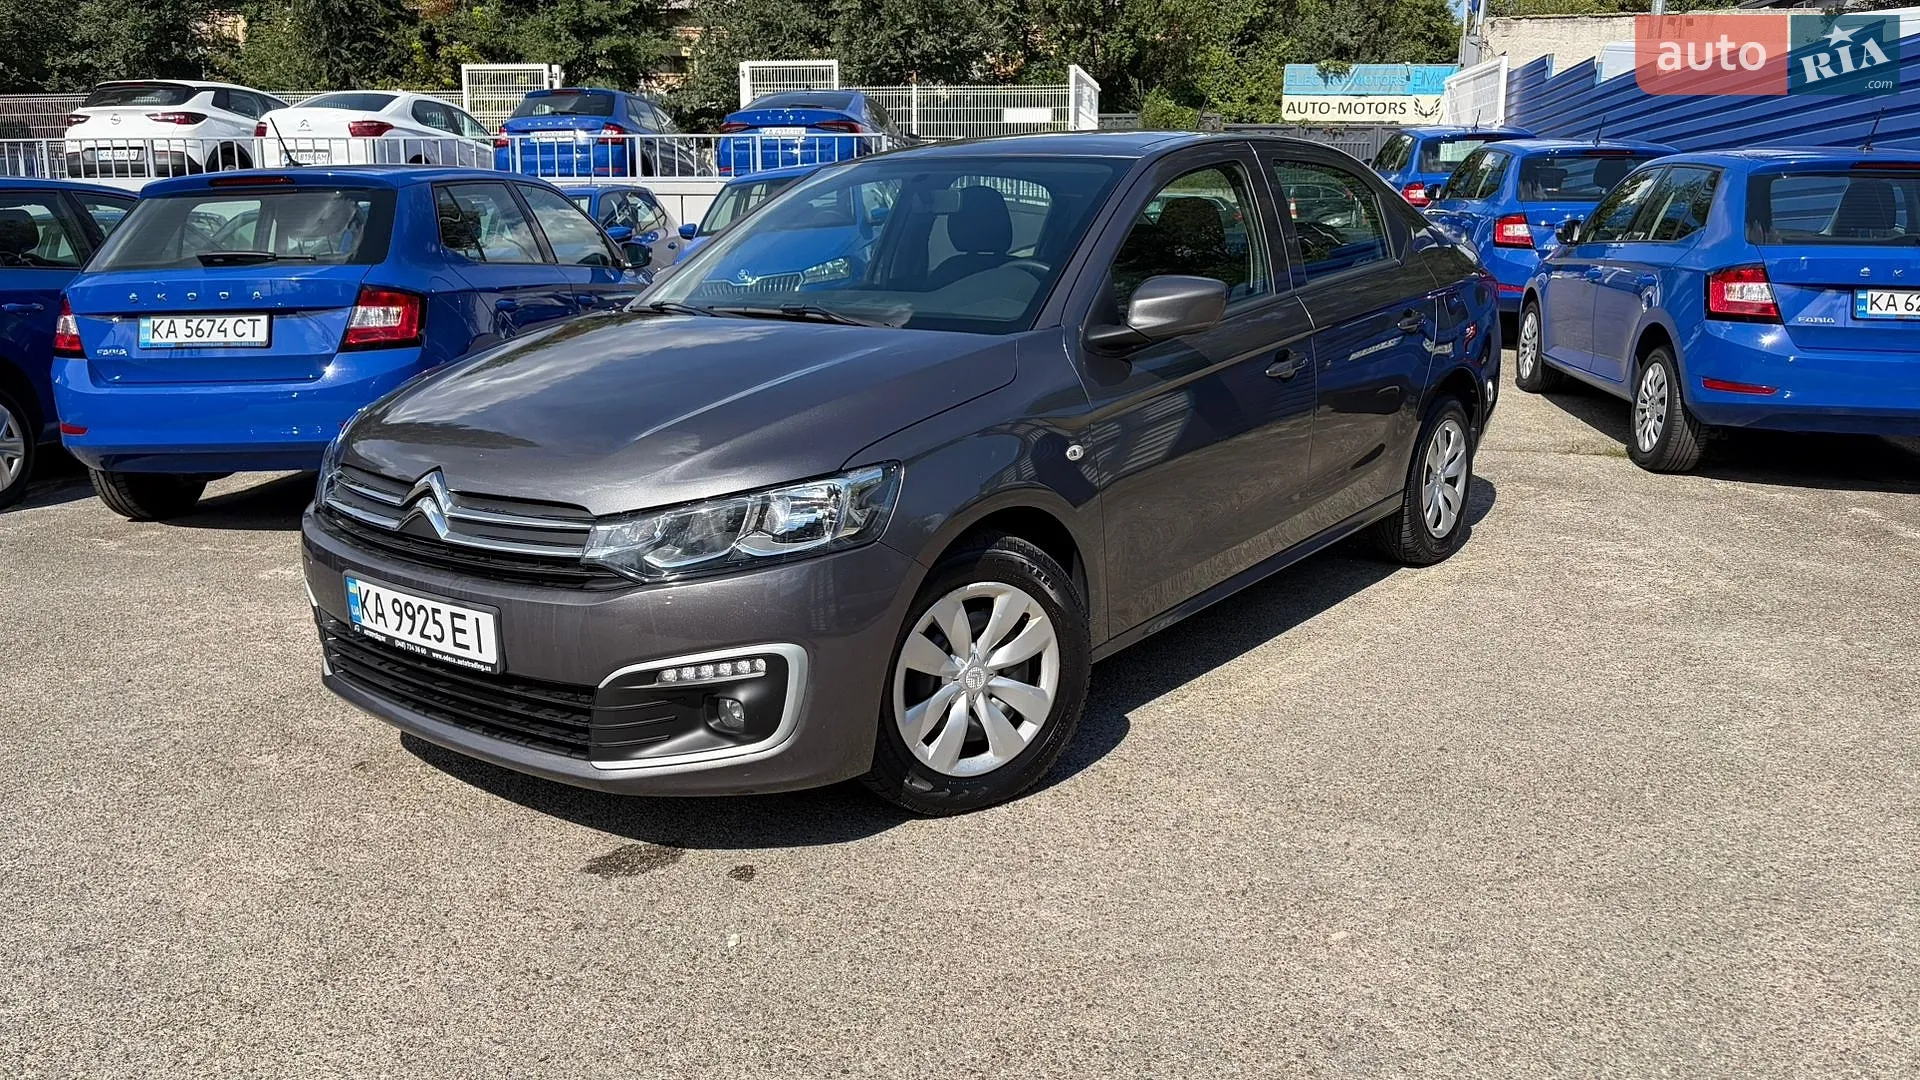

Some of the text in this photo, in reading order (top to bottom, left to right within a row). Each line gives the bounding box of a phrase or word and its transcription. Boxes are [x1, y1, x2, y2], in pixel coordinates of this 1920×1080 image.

[1285, 101, 1407, 115] AUTO-MOTORS
[1870, 293, 1898, 312] KA
[151, 318, 261, 340] KA 5674 CT
[358, 586, 483, 654] KA 9925 EI
